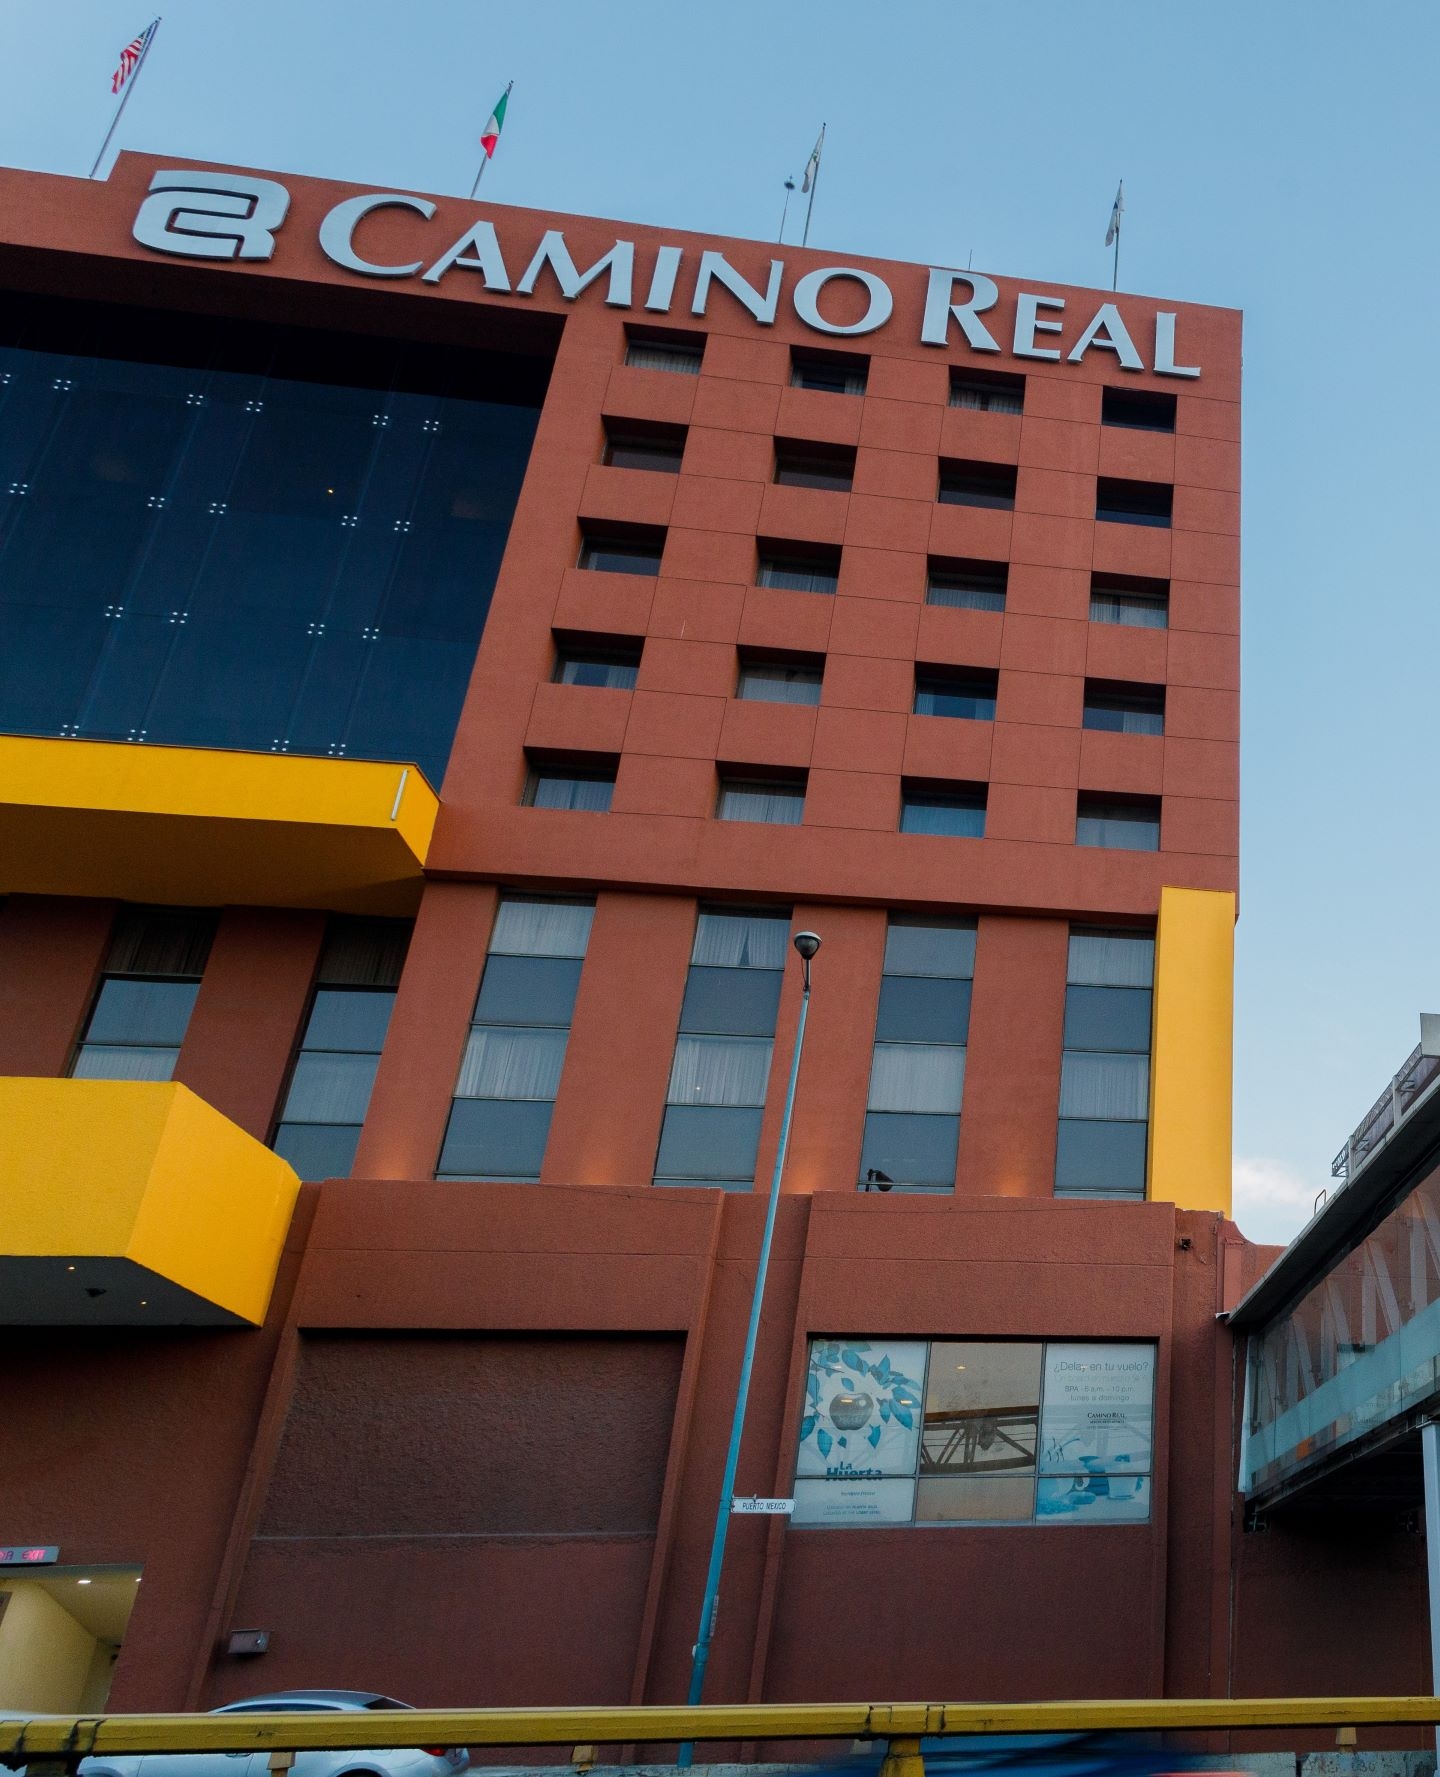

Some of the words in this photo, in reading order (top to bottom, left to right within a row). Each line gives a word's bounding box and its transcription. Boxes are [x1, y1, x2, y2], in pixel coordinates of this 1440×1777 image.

[318, 193, 893, 337] CAMINO
[920, 267, 1201, 378] REAL
[742, 1502, 764, 1511] PUERTO
